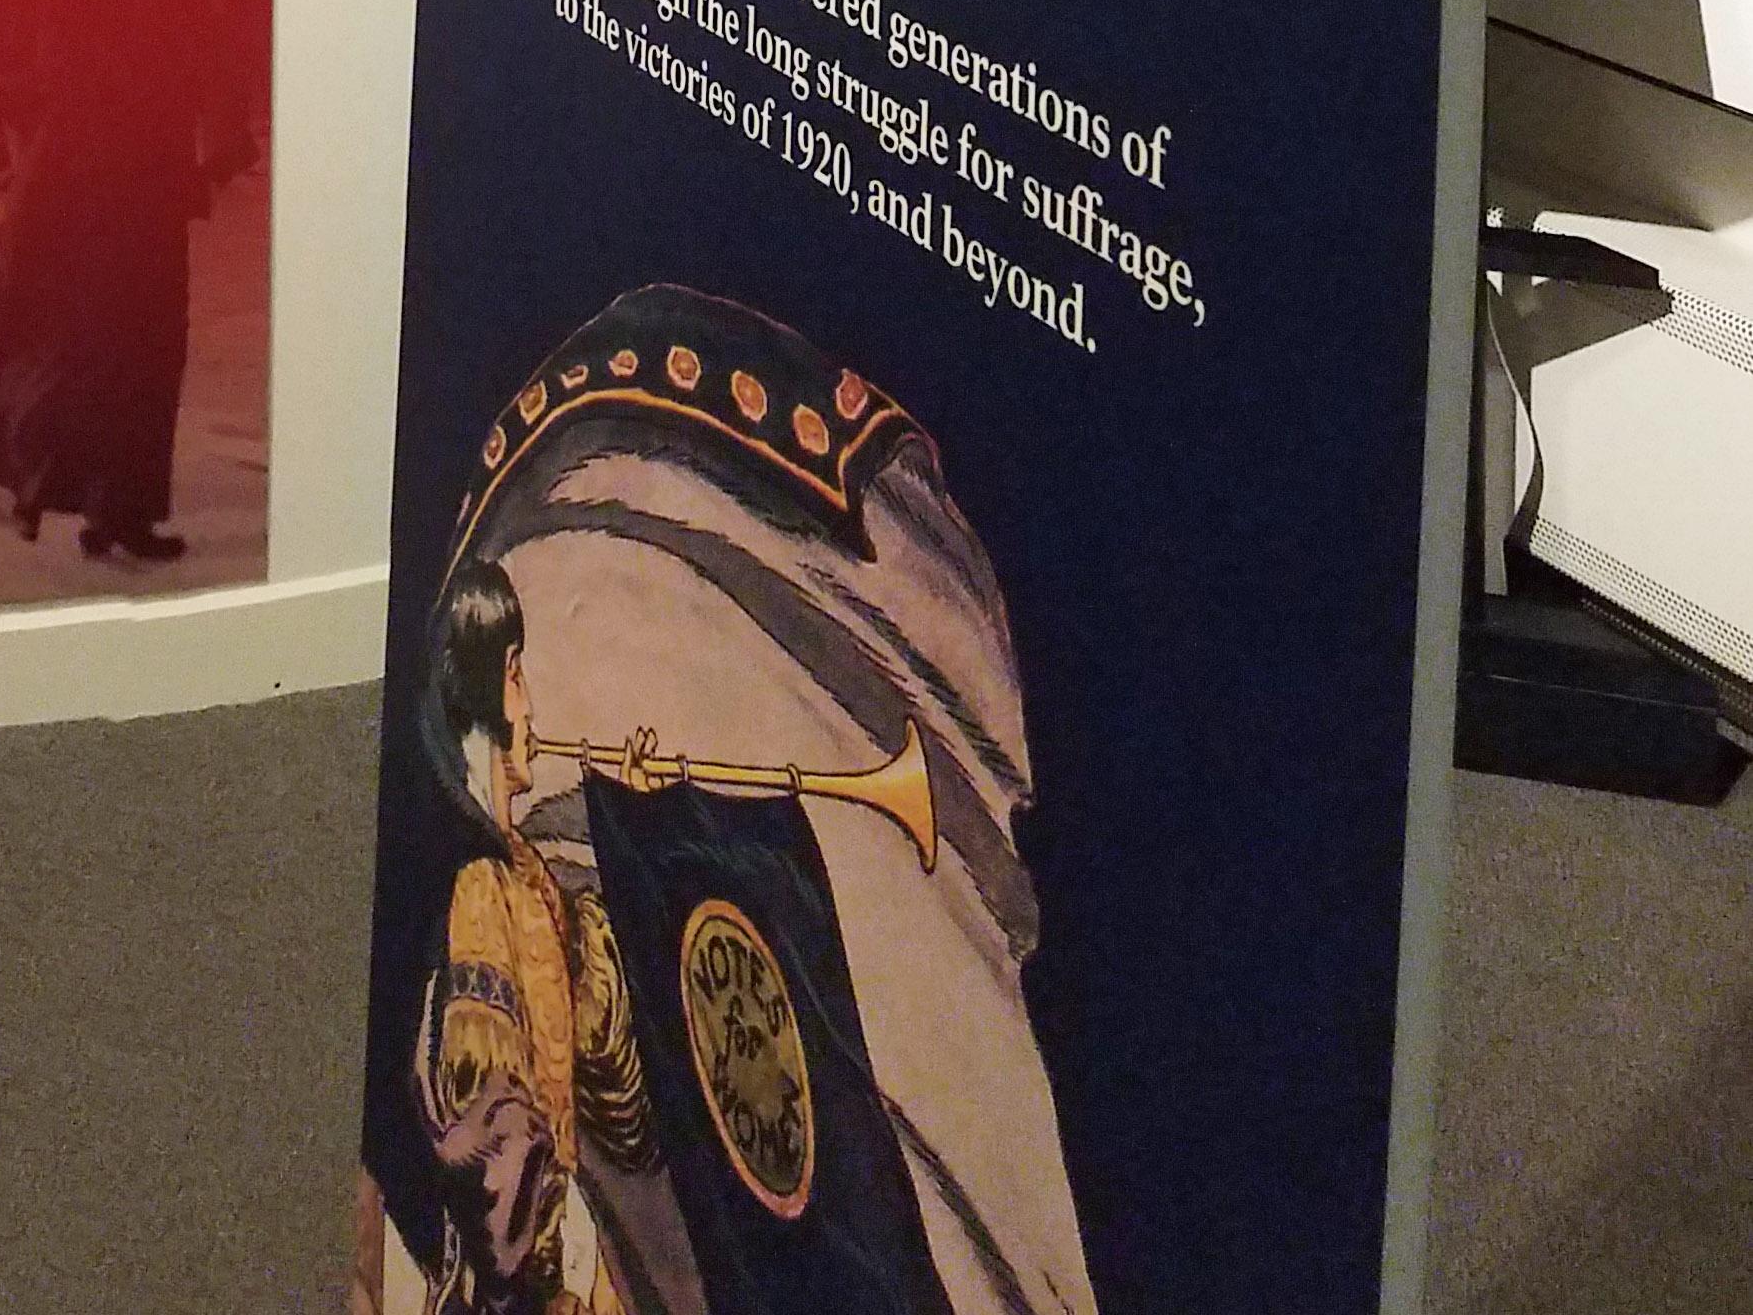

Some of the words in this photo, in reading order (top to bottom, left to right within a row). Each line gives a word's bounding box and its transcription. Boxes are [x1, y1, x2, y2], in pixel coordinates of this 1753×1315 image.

[623, 26, 736, 126] victories
[741, 96, 776, 149] of
[780, 109, 861, 215] 1920,
[866, 178, 933, 252] and
[940, 203, 1098, 354] beyond.
